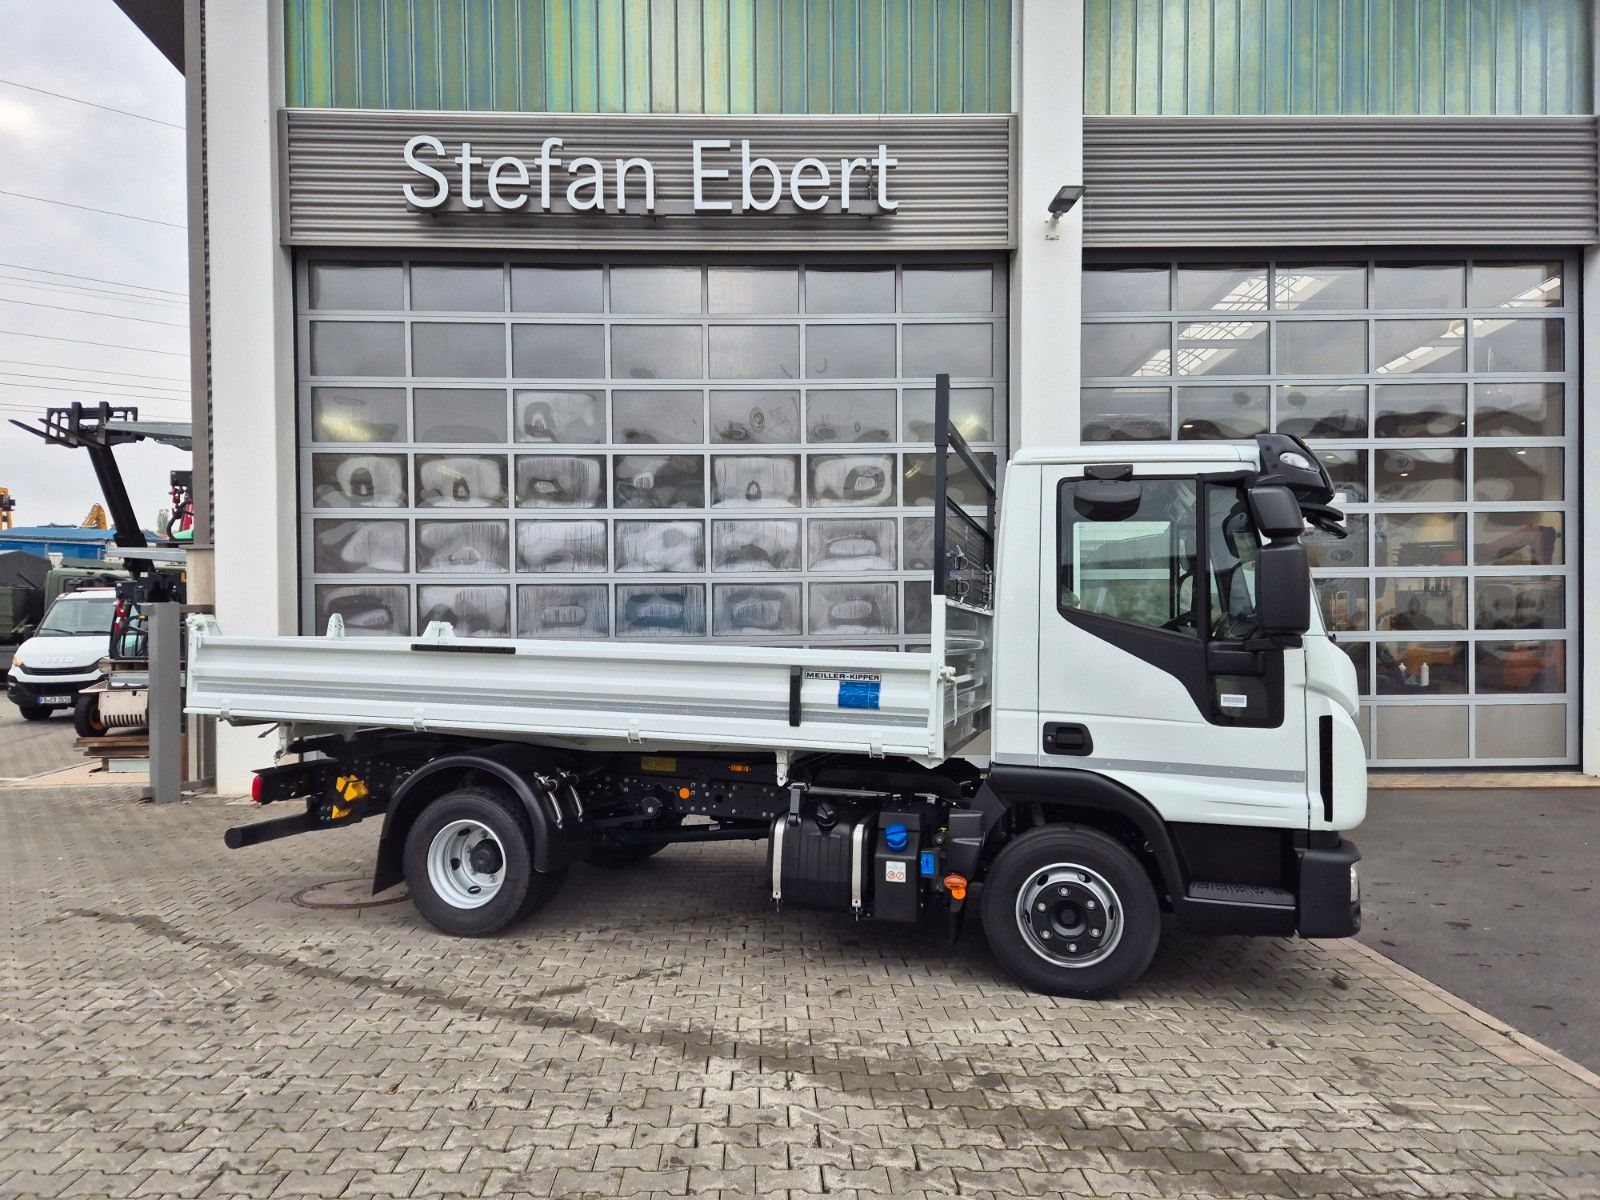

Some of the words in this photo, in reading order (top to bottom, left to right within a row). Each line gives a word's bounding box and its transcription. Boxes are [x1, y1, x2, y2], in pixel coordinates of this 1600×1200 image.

[402, 135, 655, 210] Stefan
[693, 139, 899, 211] Ebert
[806, 672, 880, 681] MEILLER-KIPPER
